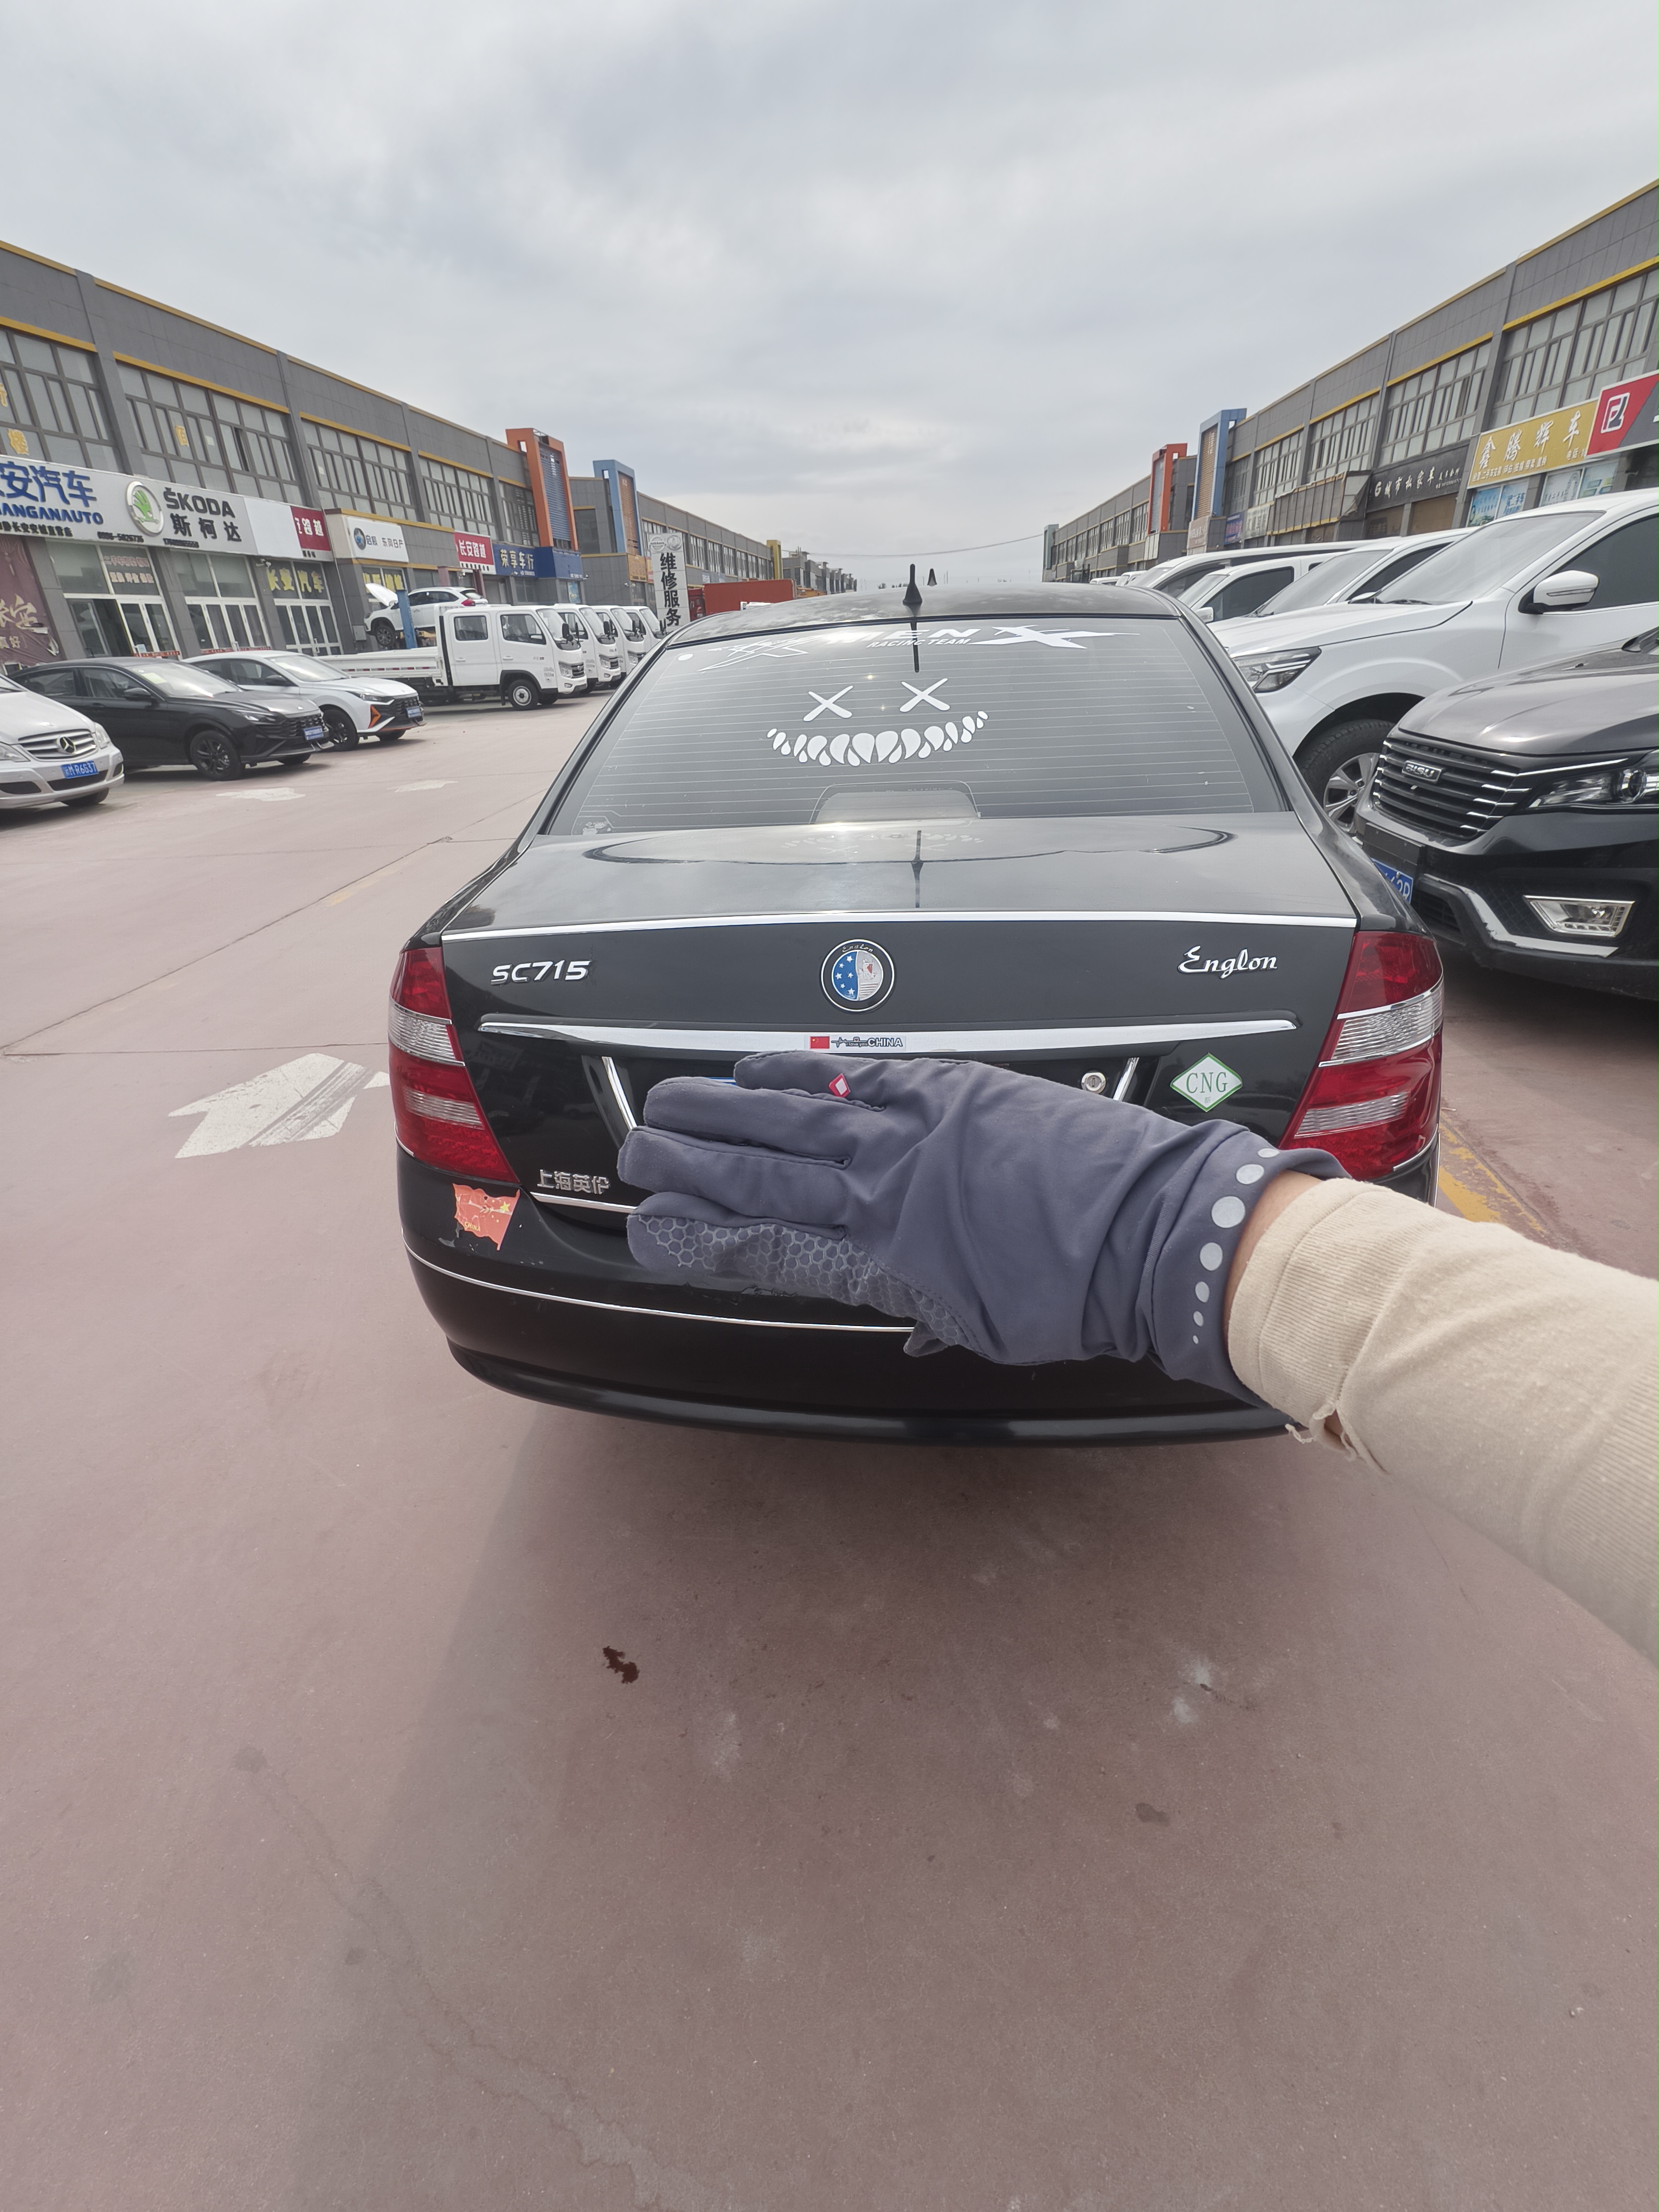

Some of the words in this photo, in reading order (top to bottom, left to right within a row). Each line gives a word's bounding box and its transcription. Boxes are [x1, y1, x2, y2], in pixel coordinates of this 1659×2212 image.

[0, 461, 97, 507] 安汽车
[0, 503, 104, 525] ANGANAUTO
[163, 487, 236, 518] ŠKODA
[170, 513, 242, 542] 斯柯达
[381, 537, 403, 549] 东风日产
[660, 552, 681, 627] 维修服务
[867, 638, 925, 648] RACING
[929, 638, 971, 646] TEAM
[491, 960, 592, 986] SC715
[1178, 946, 1278, 979] Englon
[867, 1037, 903, 1047] CHINA
[1186, 1071, 1228, 1094] CNG
[537, 1169, 610, 1194] 上海英伦
[464, 1221, 481, 1232] CHINA
